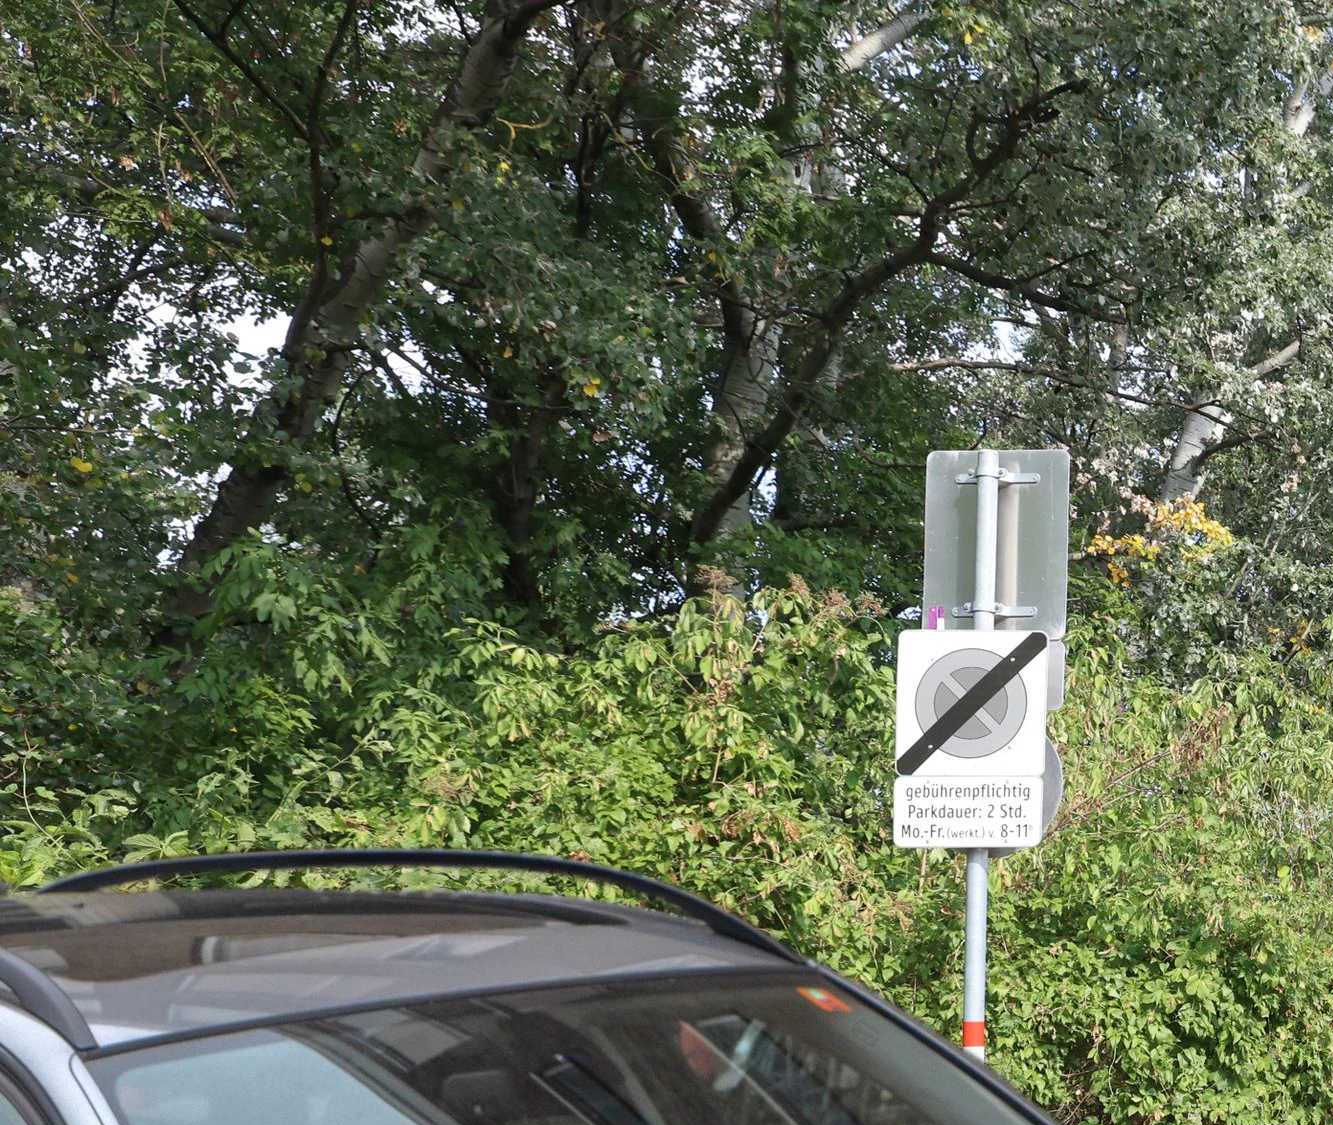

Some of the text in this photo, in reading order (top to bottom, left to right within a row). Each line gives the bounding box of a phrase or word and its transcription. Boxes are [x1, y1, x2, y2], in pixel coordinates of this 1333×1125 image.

[905, 783, 1031, 801] gebührenpflichtig
[908, 804, 1027, 819] Parkdauer: 2 Std.
[901, 824, 945, 839] Mo.-Fr.
